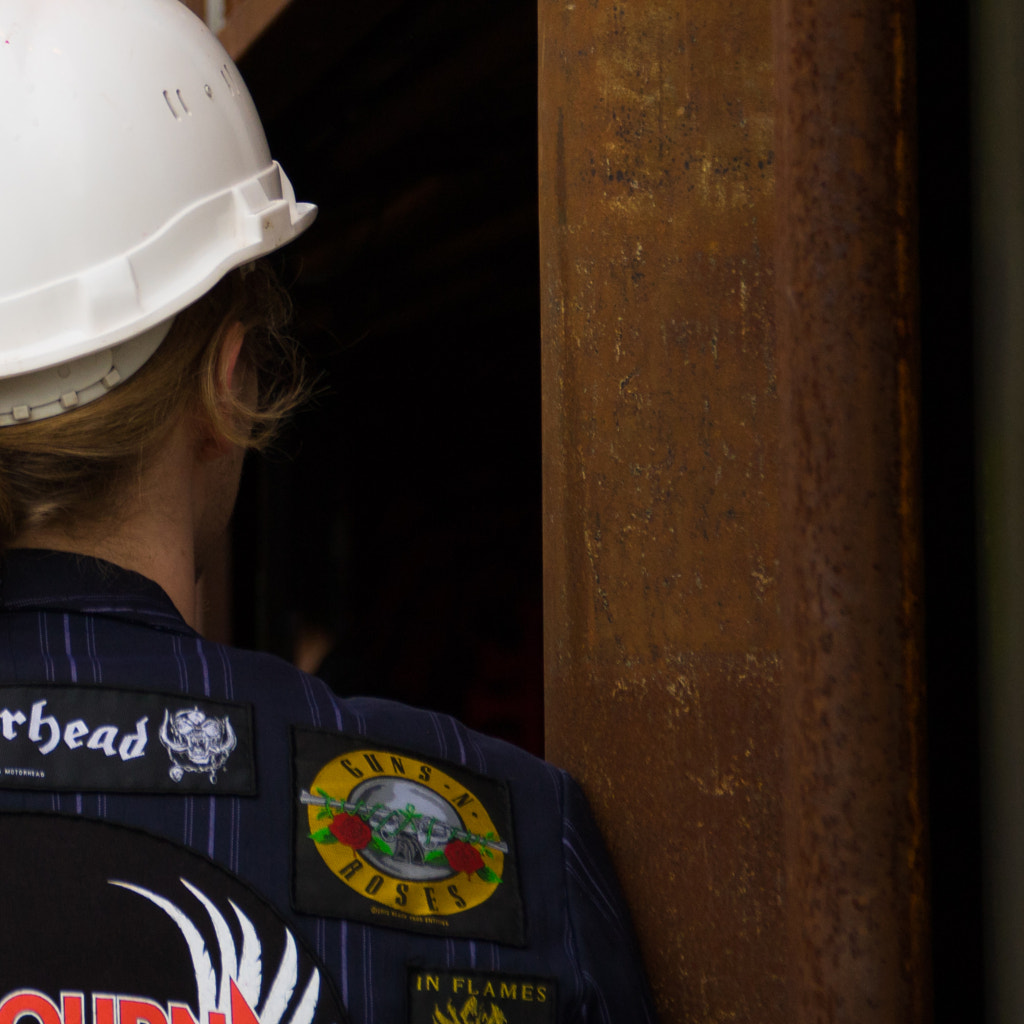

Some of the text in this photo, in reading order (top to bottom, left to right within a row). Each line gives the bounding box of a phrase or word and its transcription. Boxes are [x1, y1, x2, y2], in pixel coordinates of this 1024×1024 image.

[339, 859, 467, 912] ROSES
[417, 975, 547, 1002] IN FLAMES
